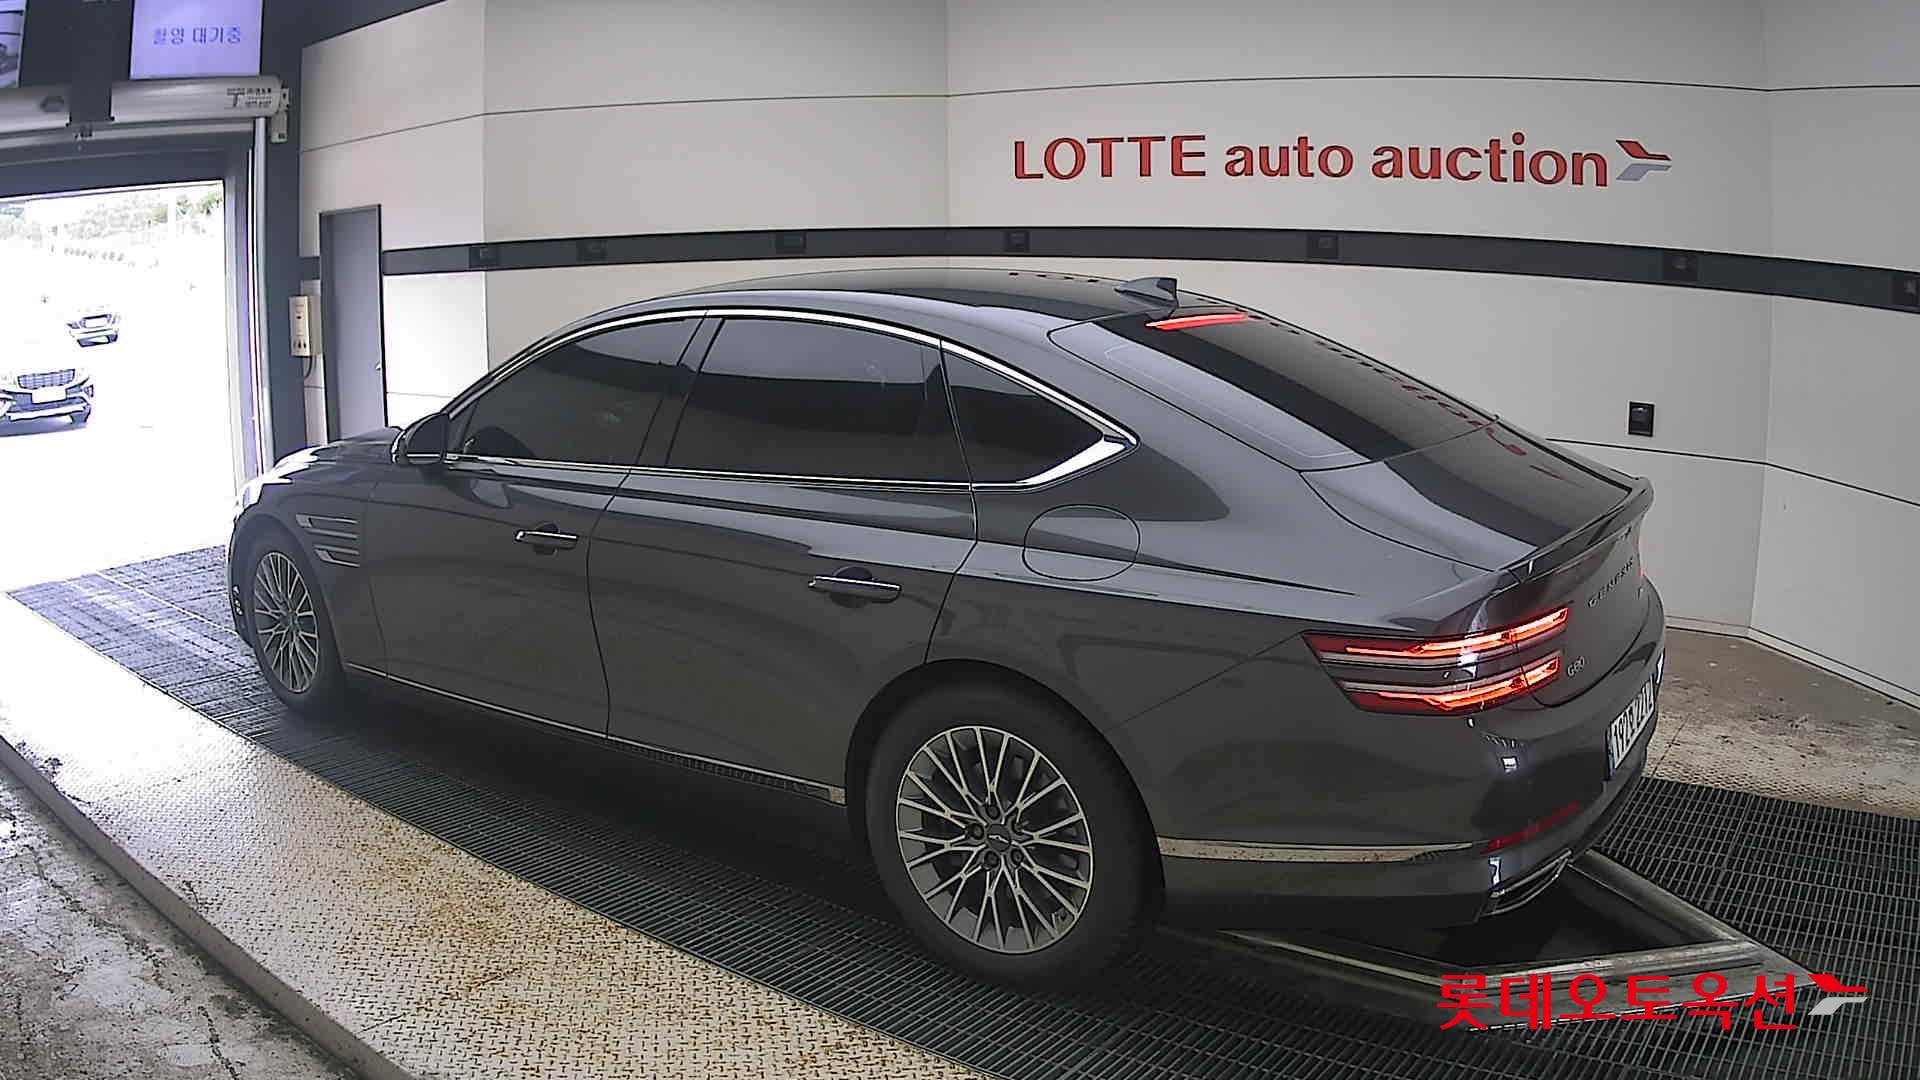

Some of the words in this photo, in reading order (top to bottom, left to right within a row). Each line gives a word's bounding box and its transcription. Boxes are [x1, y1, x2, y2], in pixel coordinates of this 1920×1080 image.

[192, 25, 241, 44] 대기중
[1014, 135, 1206, 179] LOTTE
[1224, 136, 1353, 177] auto
[1371, 132, 1607, 186] auction
[1567, 655, 1586, 678] G80
